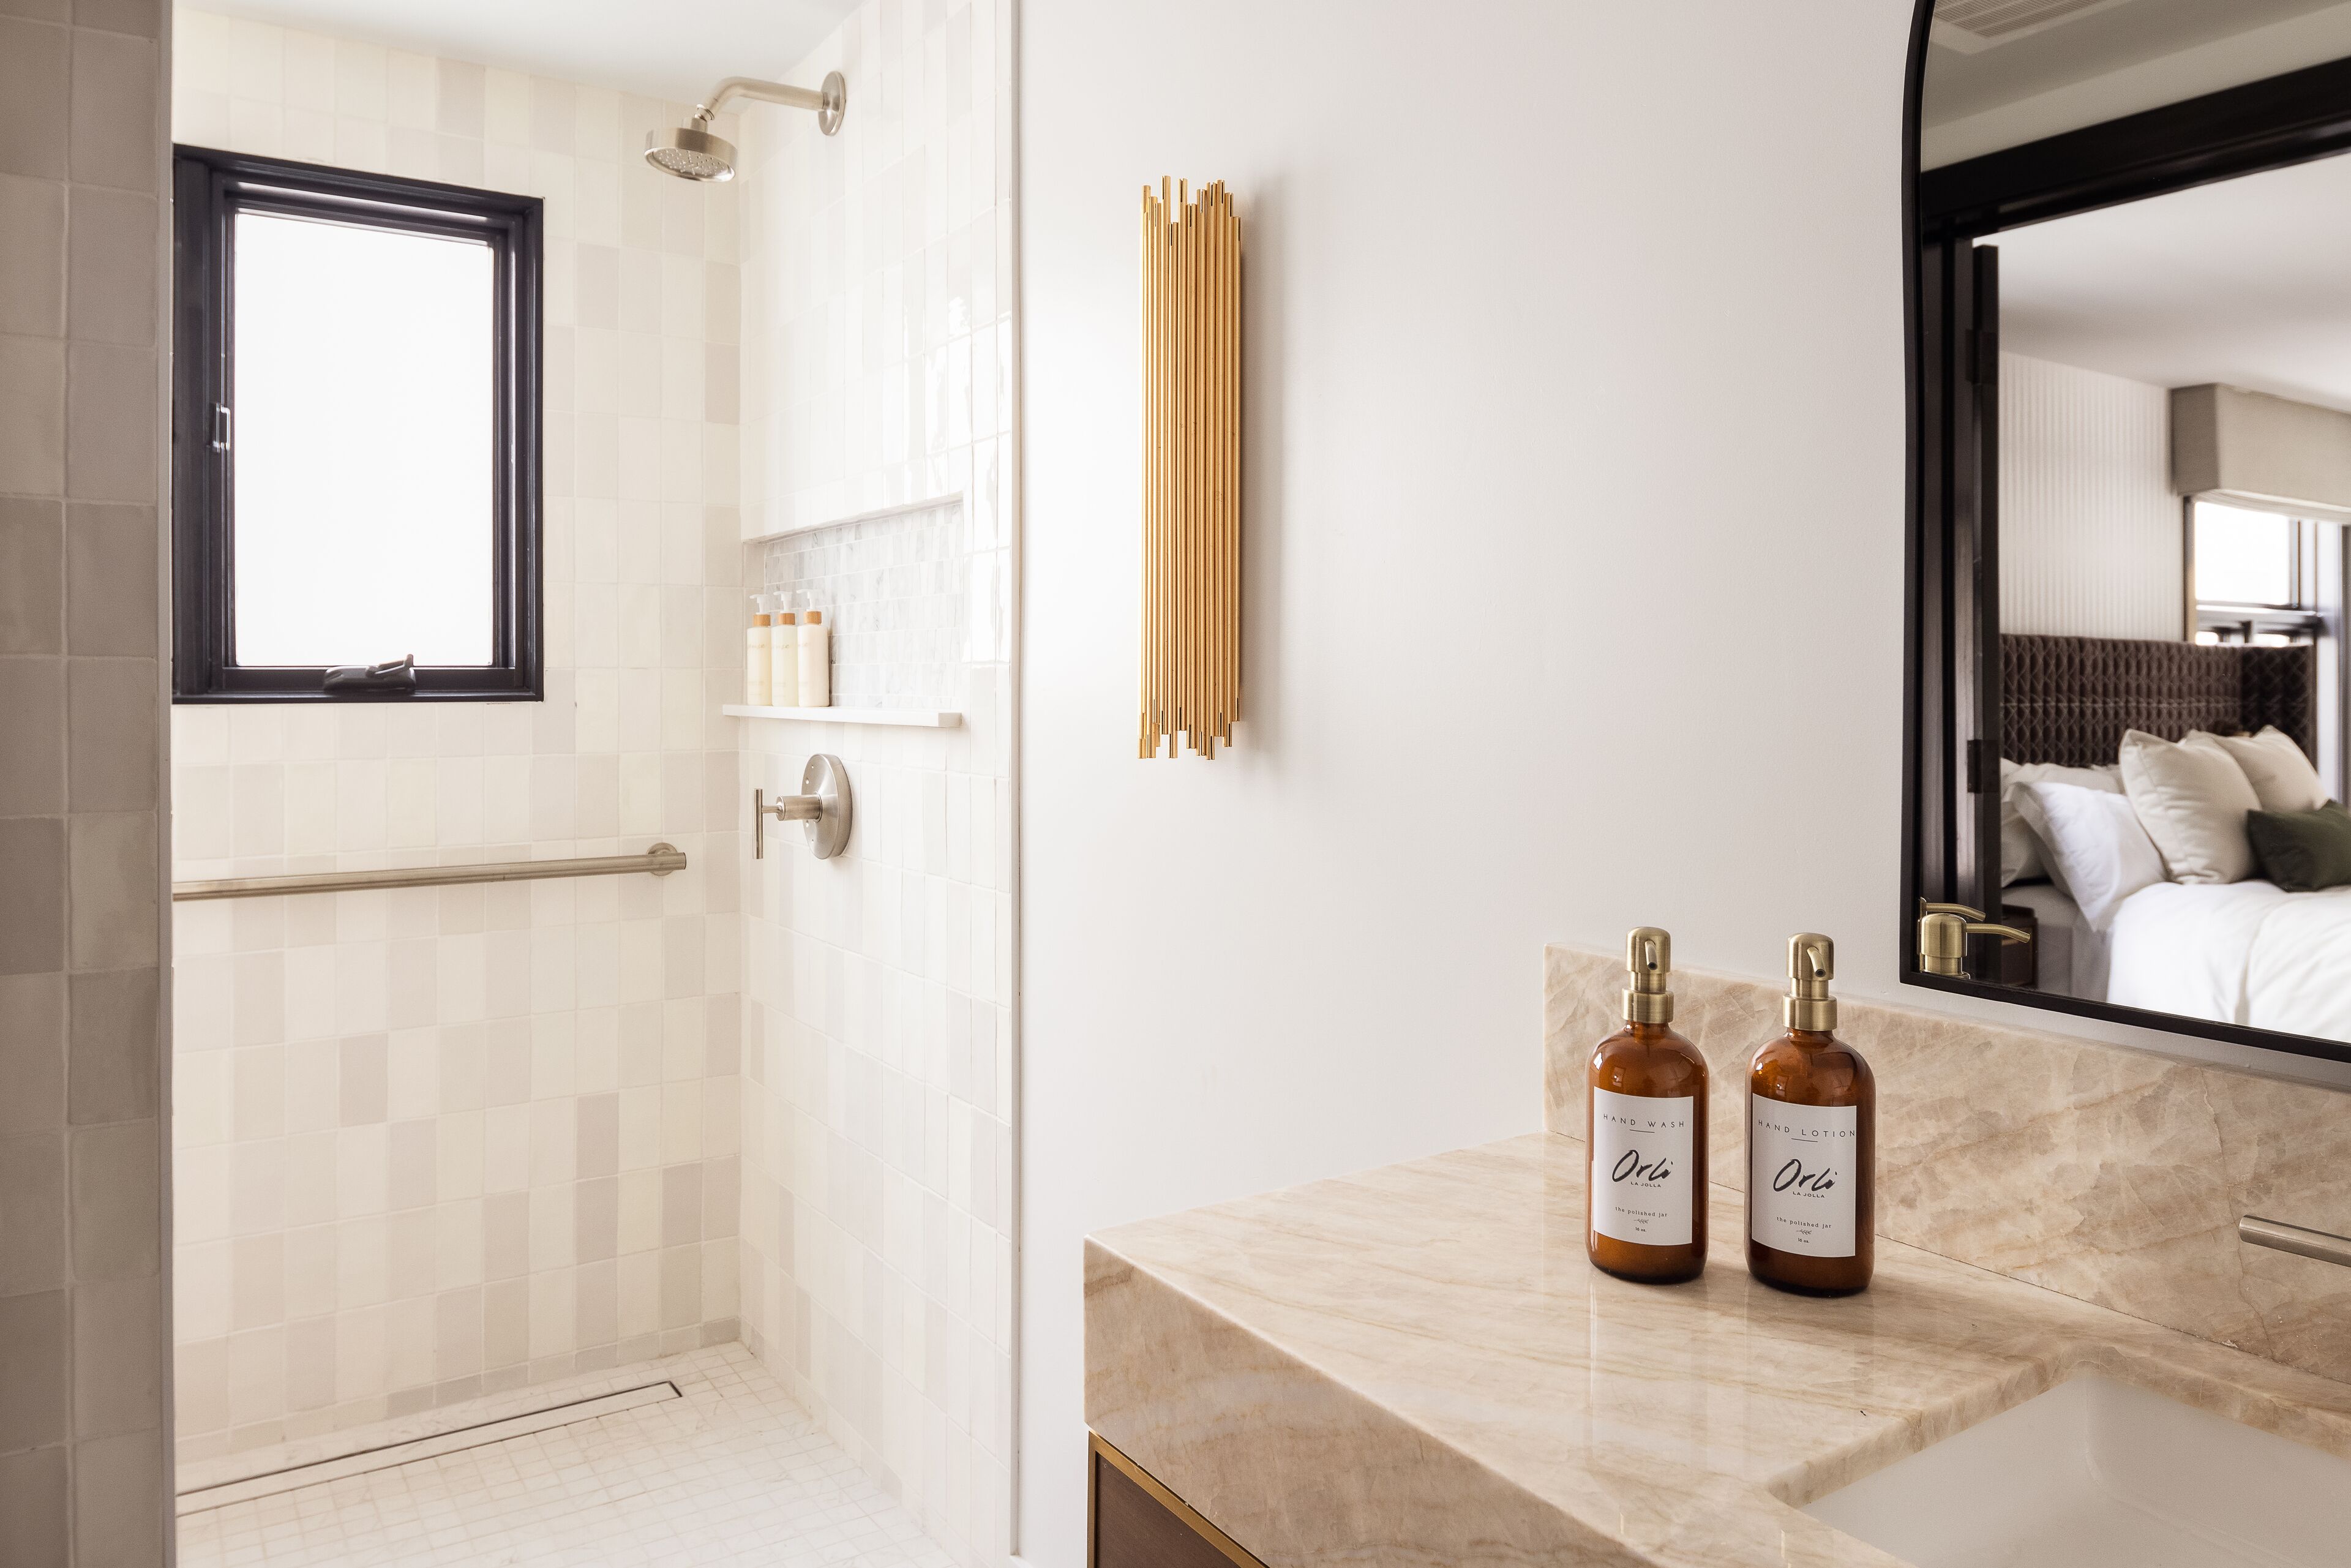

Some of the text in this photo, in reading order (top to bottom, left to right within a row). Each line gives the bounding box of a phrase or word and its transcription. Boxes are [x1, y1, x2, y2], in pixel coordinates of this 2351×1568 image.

[1603, 1113, 1636, 1126] HAND
[1758, 1119, 1855, 1138] HAND LOTION
[1611, 1149, 1674, 1182] Orli
[1773, 1158, 1838, 1192] Orli
